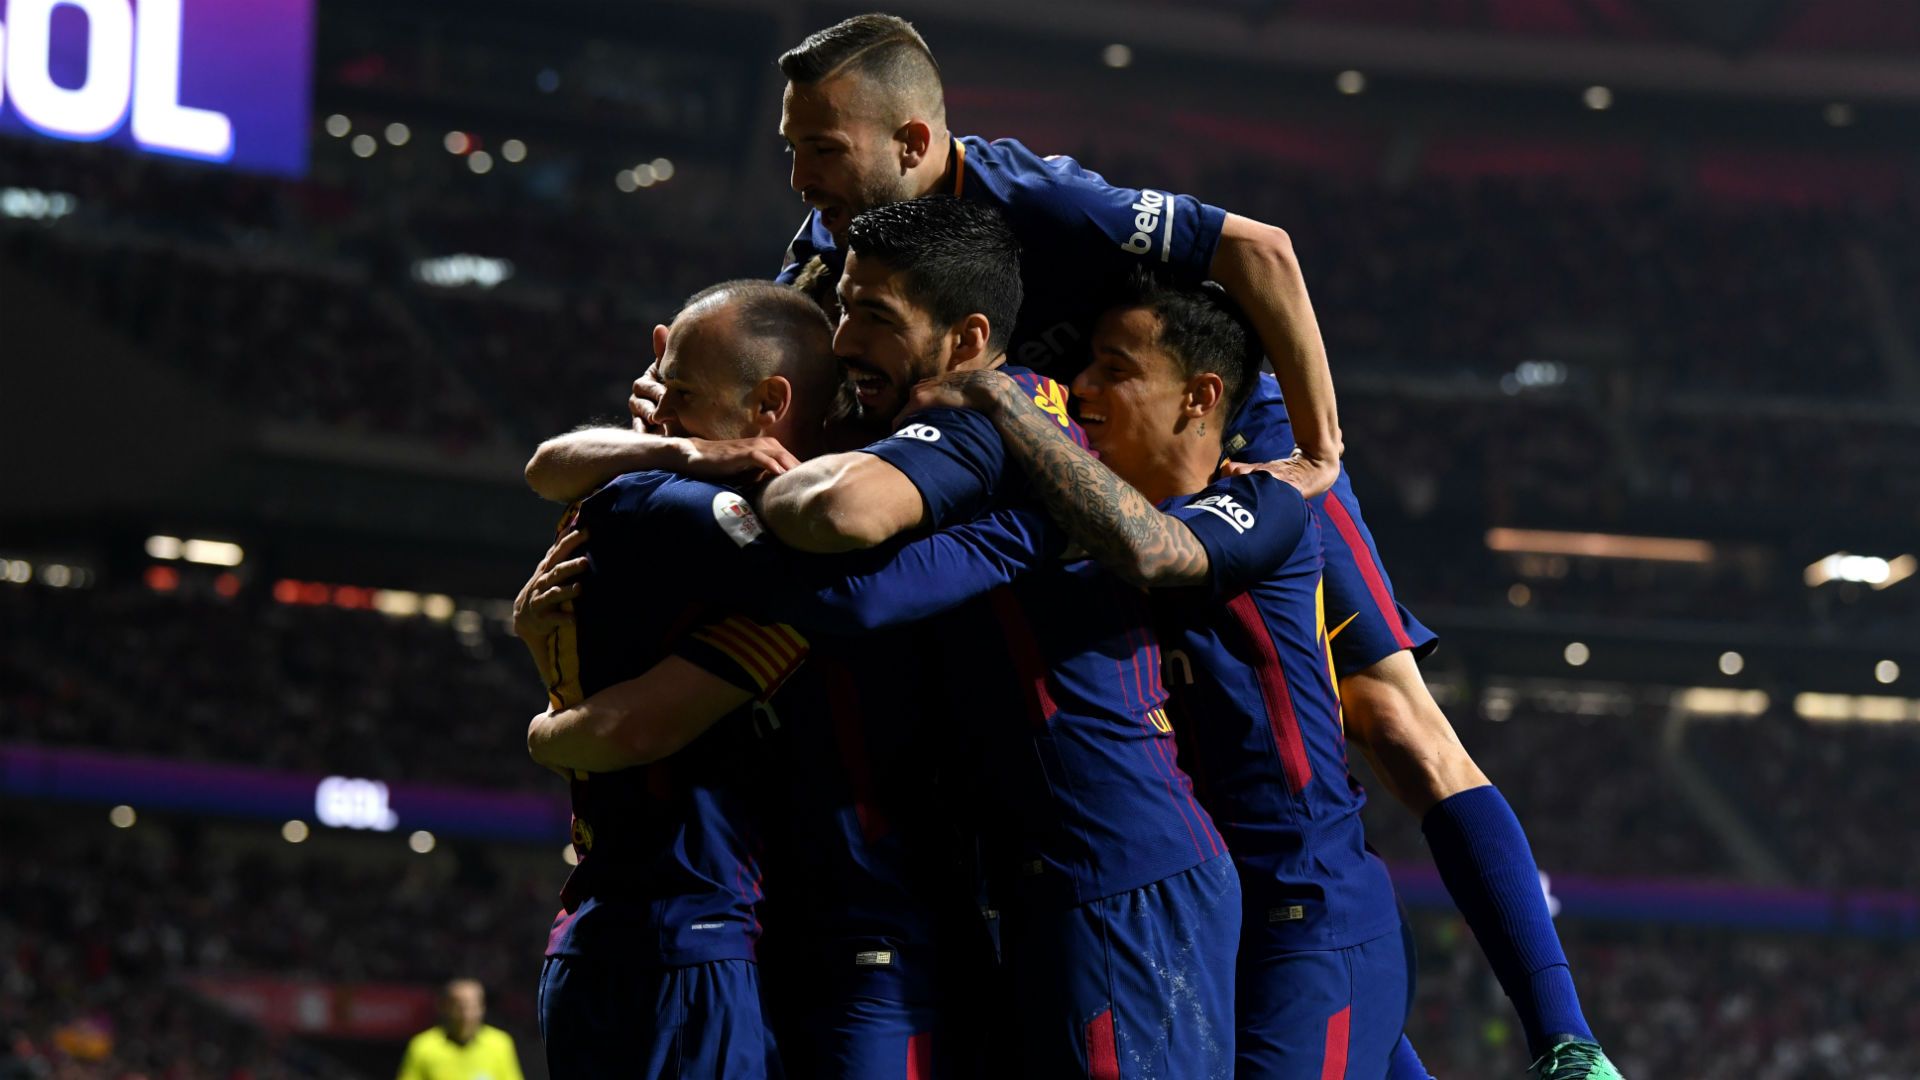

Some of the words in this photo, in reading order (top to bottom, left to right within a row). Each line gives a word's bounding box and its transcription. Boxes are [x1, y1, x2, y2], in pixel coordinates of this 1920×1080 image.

[0, 0, 235, 163] OL
[1121, 188, 1164, 255] beko
[315, 775, 399, 832] GOL
